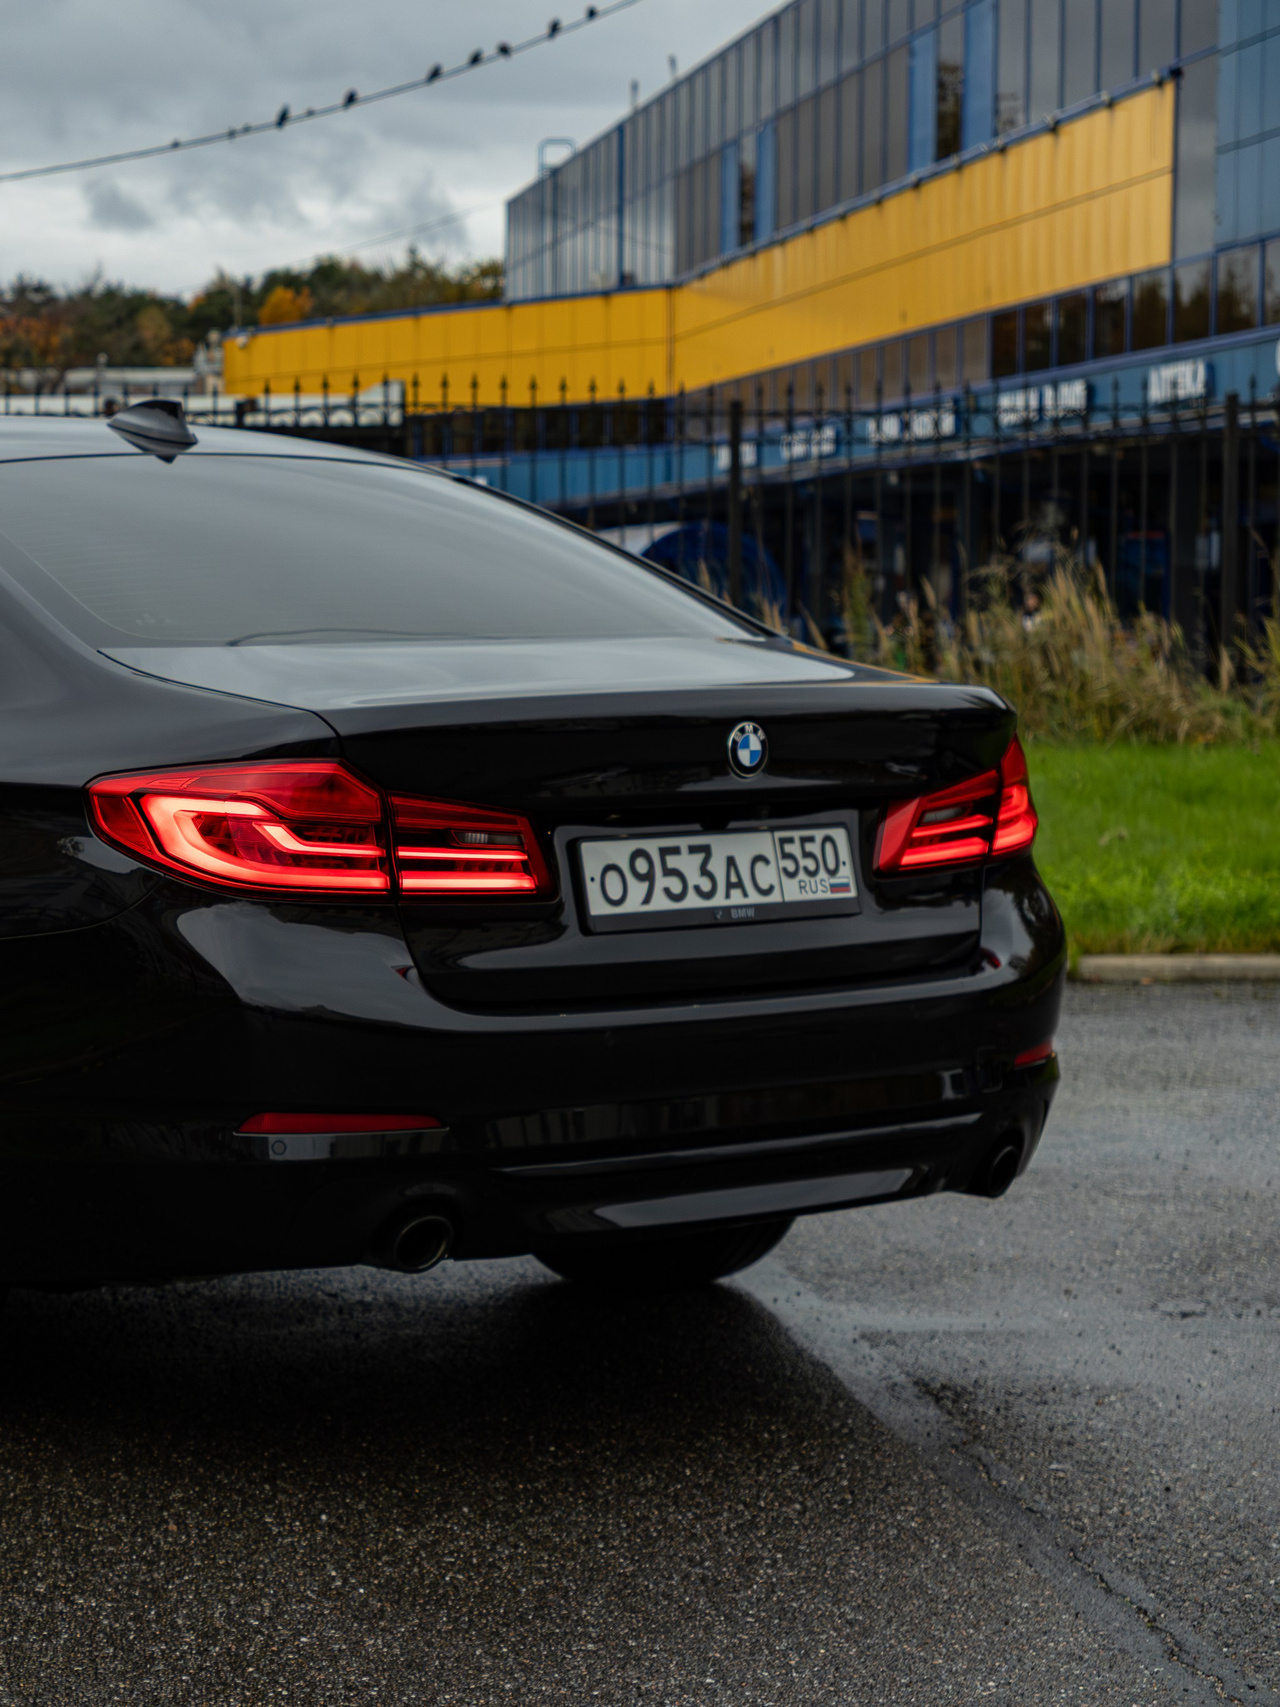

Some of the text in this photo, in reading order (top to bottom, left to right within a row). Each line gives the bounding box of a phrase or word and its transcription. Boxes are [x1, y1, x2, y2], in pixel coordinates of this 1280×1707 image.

[778, 834, 841, 879] 550
[798, 878, 829, 895] RUS
[730, 906, 755, 919] BMW
